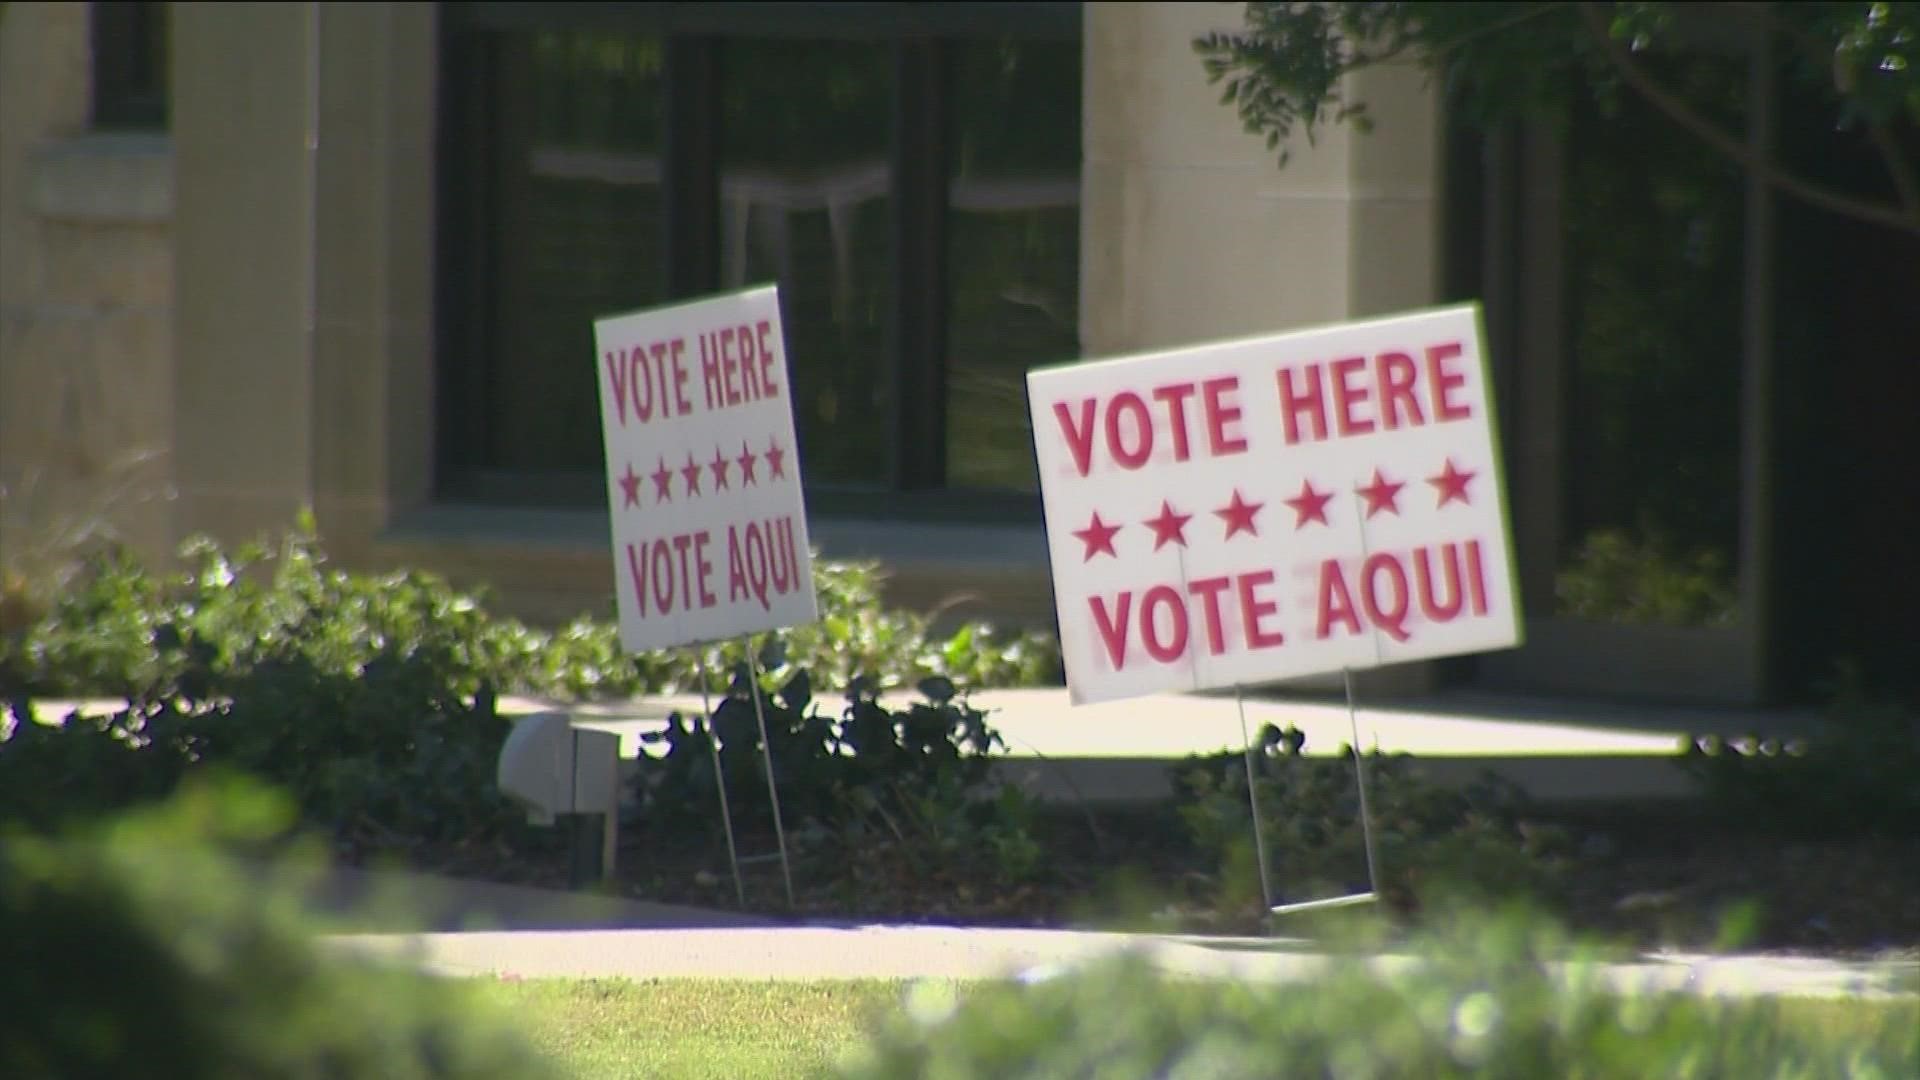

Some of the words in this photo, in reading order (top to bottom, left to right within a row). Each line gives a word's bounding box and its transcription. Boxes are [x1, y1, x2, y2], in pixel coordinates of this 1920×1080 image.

[606, 338, 692, 428] VOTE
[700, 321, 778, 410] HERE
[1053, 376, 1248, 478] VOTE
[1276, 343, 1471, 445] HERE
[627, 531, 716, 618] VOTE
[728, 517, 800, 612] AQUI
[1088, 570, 1283, 672] VOTE
[1315, 540, 1488, 643] AQUI
